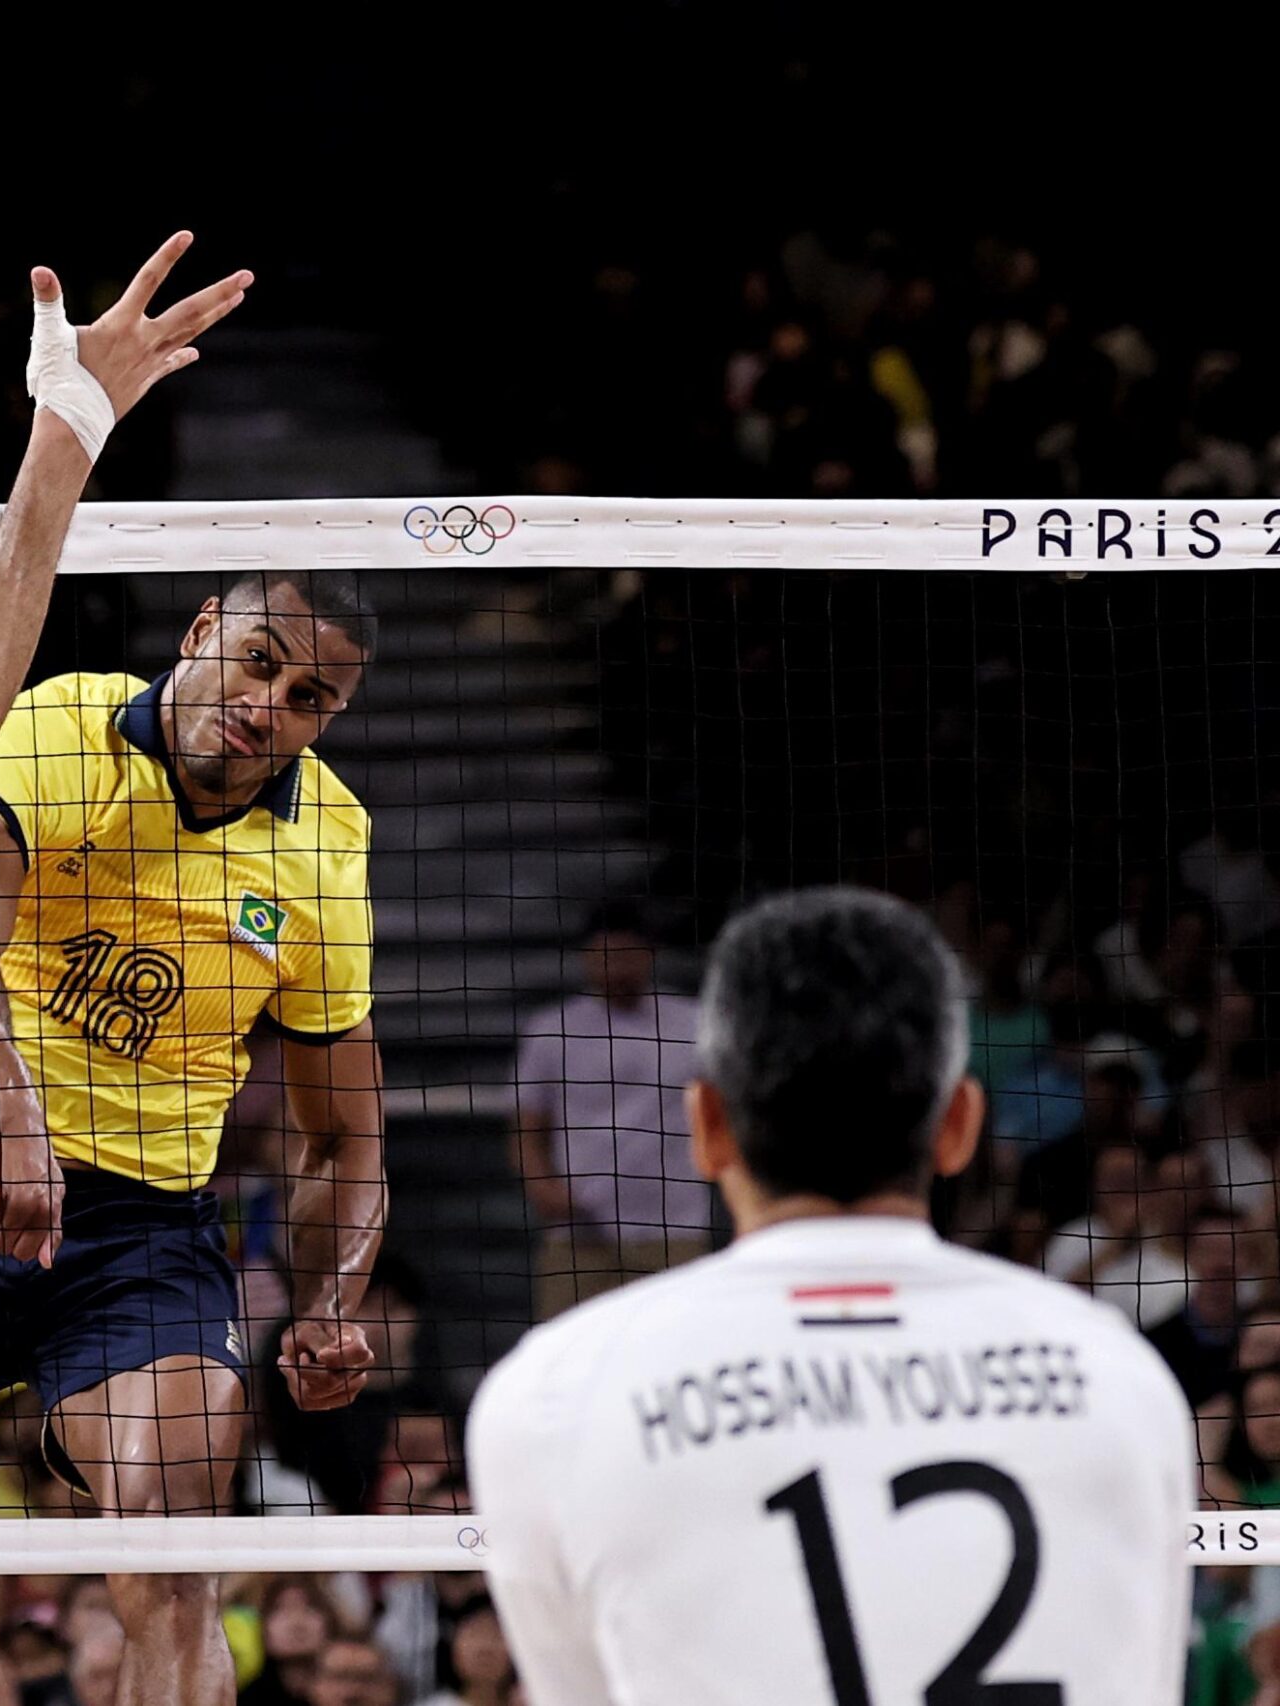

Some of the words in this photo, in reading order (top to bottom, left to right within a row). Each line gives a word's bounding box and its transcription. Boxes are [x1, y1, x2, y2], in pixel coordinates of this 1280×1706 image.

[42, 928, 184, 1059] 18
[632, 1355, 864, 1461] HOSSAM
[864, 1342, 1088, 1426] YOUSSEF
[763, 1459, 1065, 1706] 12
